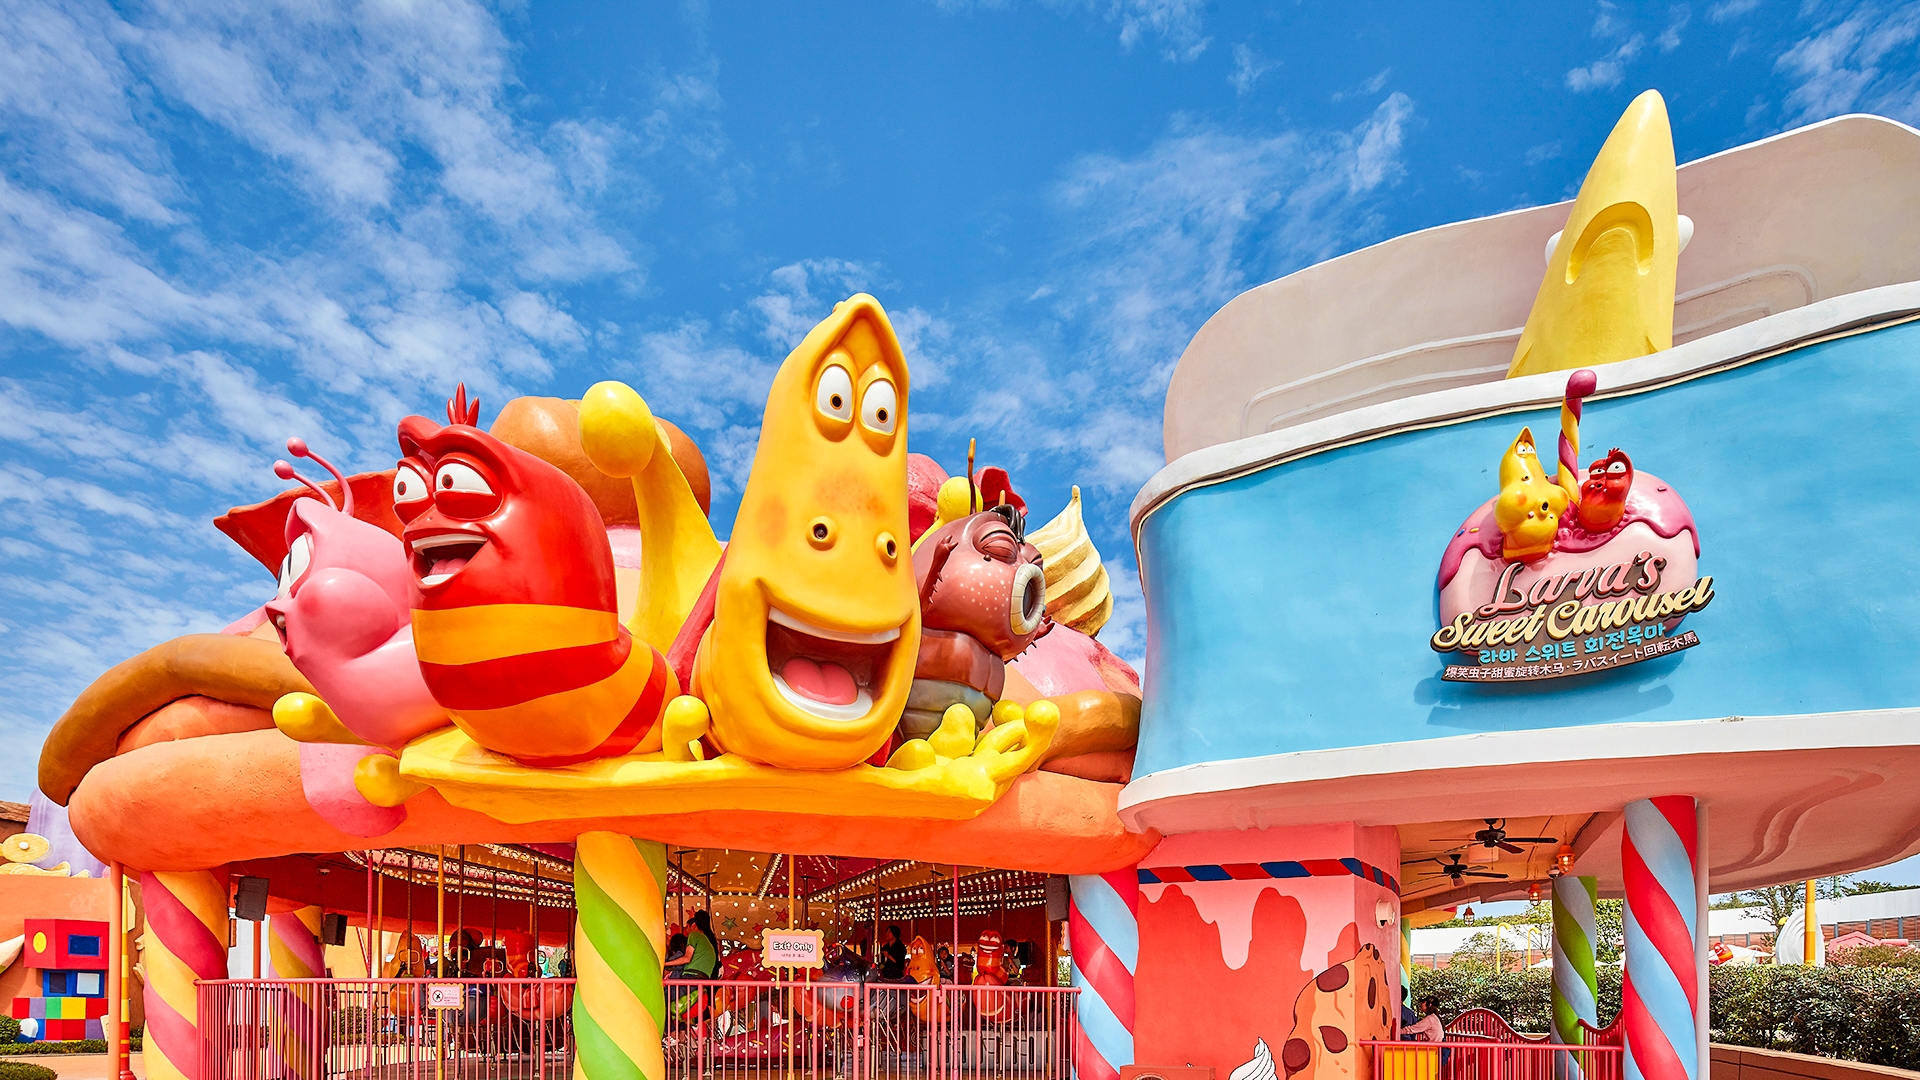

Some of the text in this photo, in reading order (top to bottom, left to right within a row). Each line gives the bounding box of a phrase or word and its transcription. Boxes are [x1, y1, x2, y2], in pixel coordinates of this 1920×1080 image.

[1479, 550, 1665, 617] Larva's
[1433, 576, 1714, 649] Sweet Carousel
[1479, 622, 1666, 664] 라바 스위트 회전목마
[773, 941, 814, 953] Exit Only
